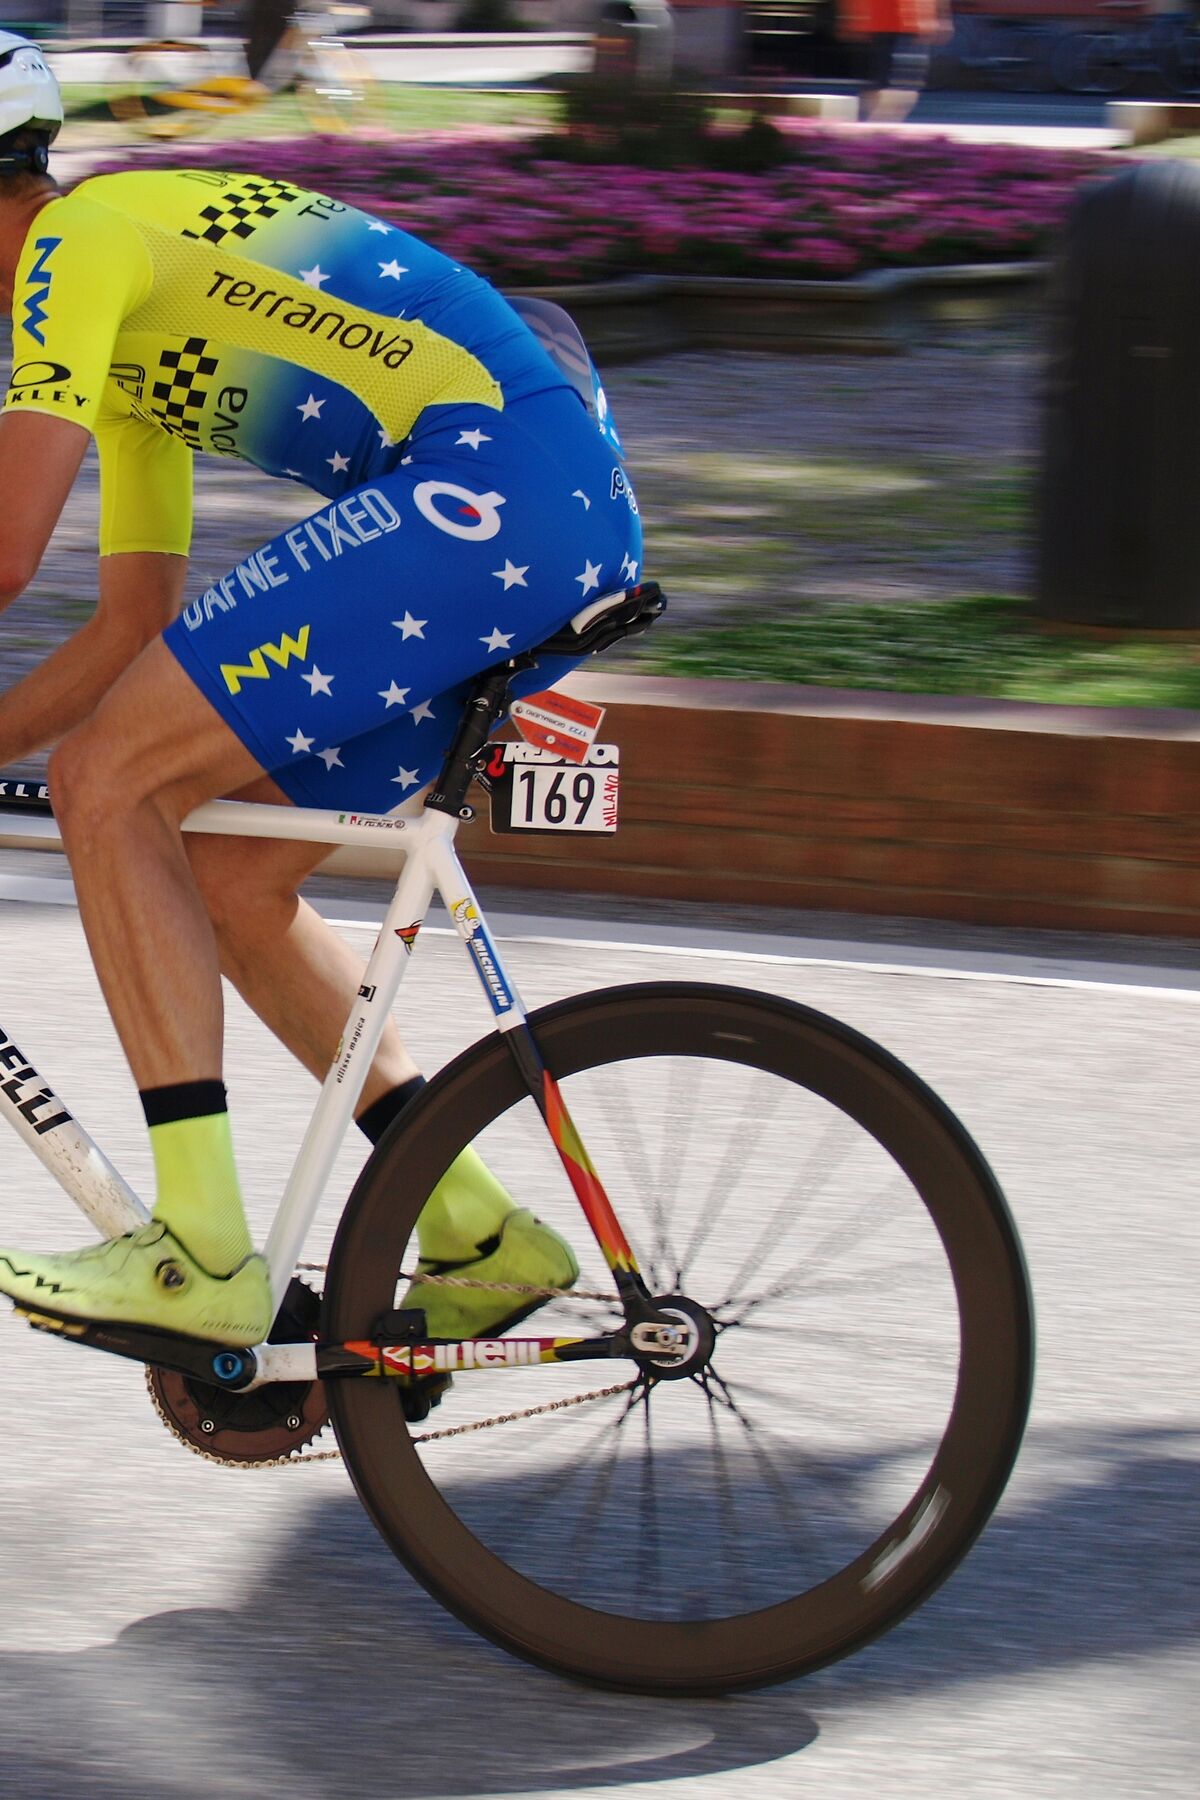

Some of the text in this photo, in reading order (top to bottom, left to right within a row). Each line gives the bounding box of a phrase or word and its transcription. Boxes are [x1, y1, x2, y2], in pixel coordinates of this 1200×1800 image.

[206, 270, 414, 370] Terranova
[3, 390, 91, 408] KLEY
[182, 488, 402, 632] DAFNE FIXED
[219, 623, 311, 696] NW
[519, 770, 595, 825] 169
[602, 774, 619, 827] MILANO
[473, 939, 509, 1007] MICHELIN
[337, 1017, 366, 1084] ellisse magica
